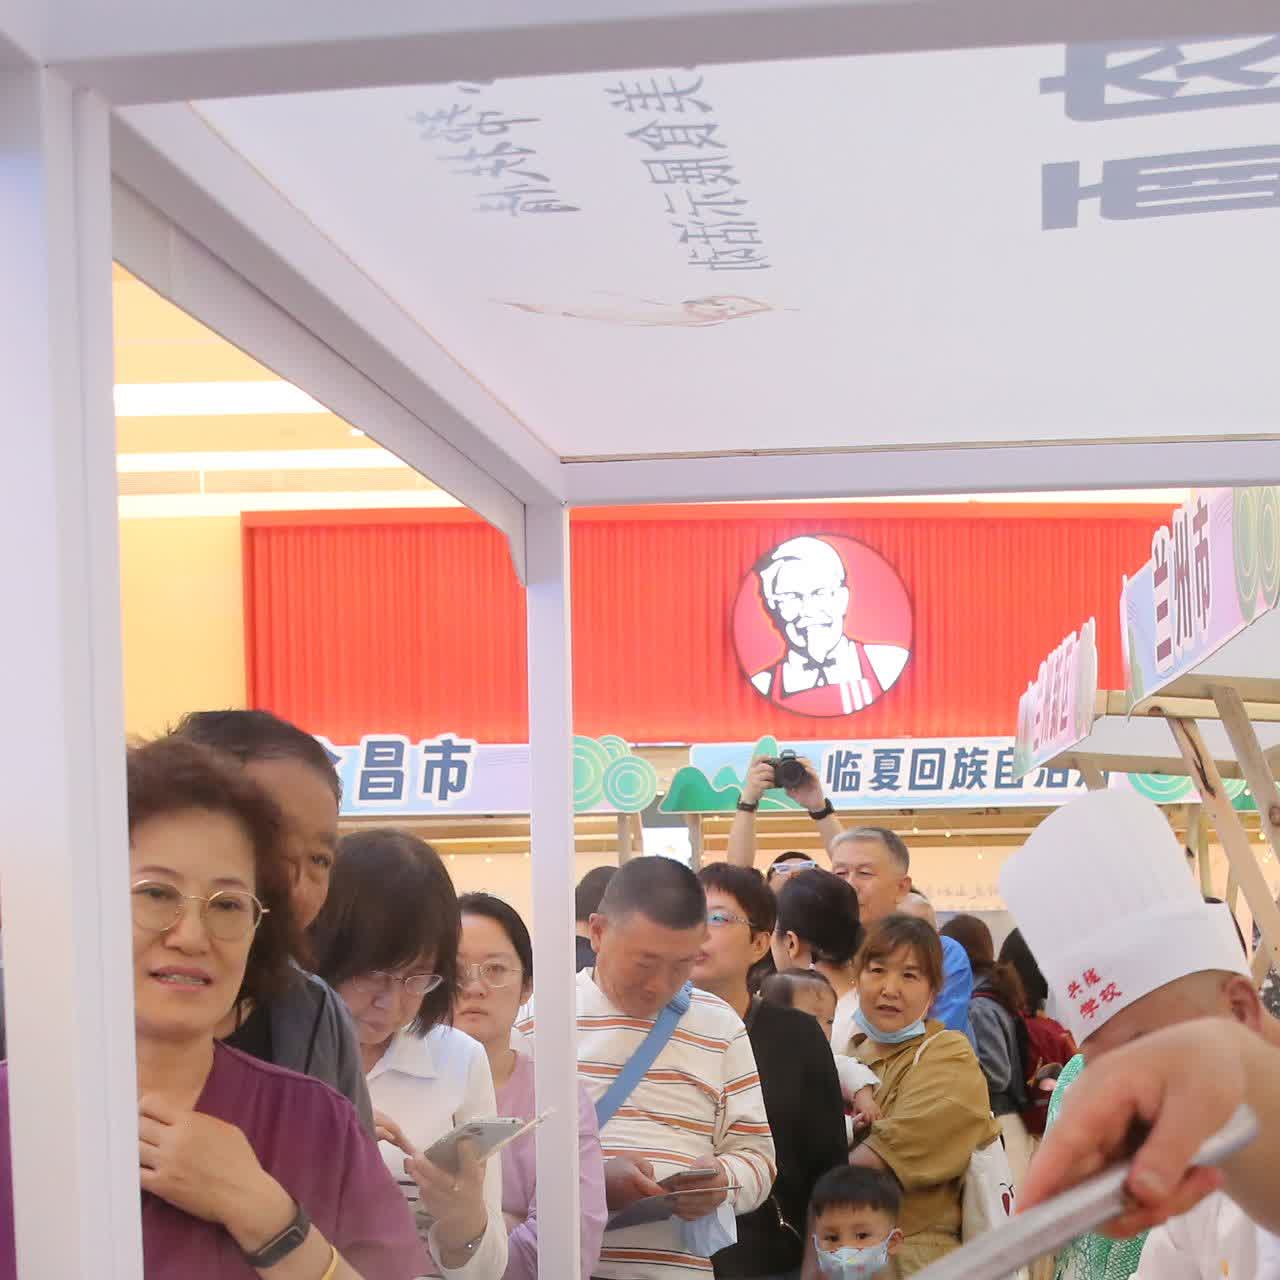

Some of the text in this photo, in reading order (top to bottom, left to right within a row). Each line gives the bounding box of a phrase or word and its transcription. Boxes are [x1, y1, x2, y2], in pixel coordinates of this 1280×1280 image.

[1153, 495, 1210, 663] 兰州市
[326, 739, 471, 801] 昌市
[1080, 982, 1122, 1019] 学校
